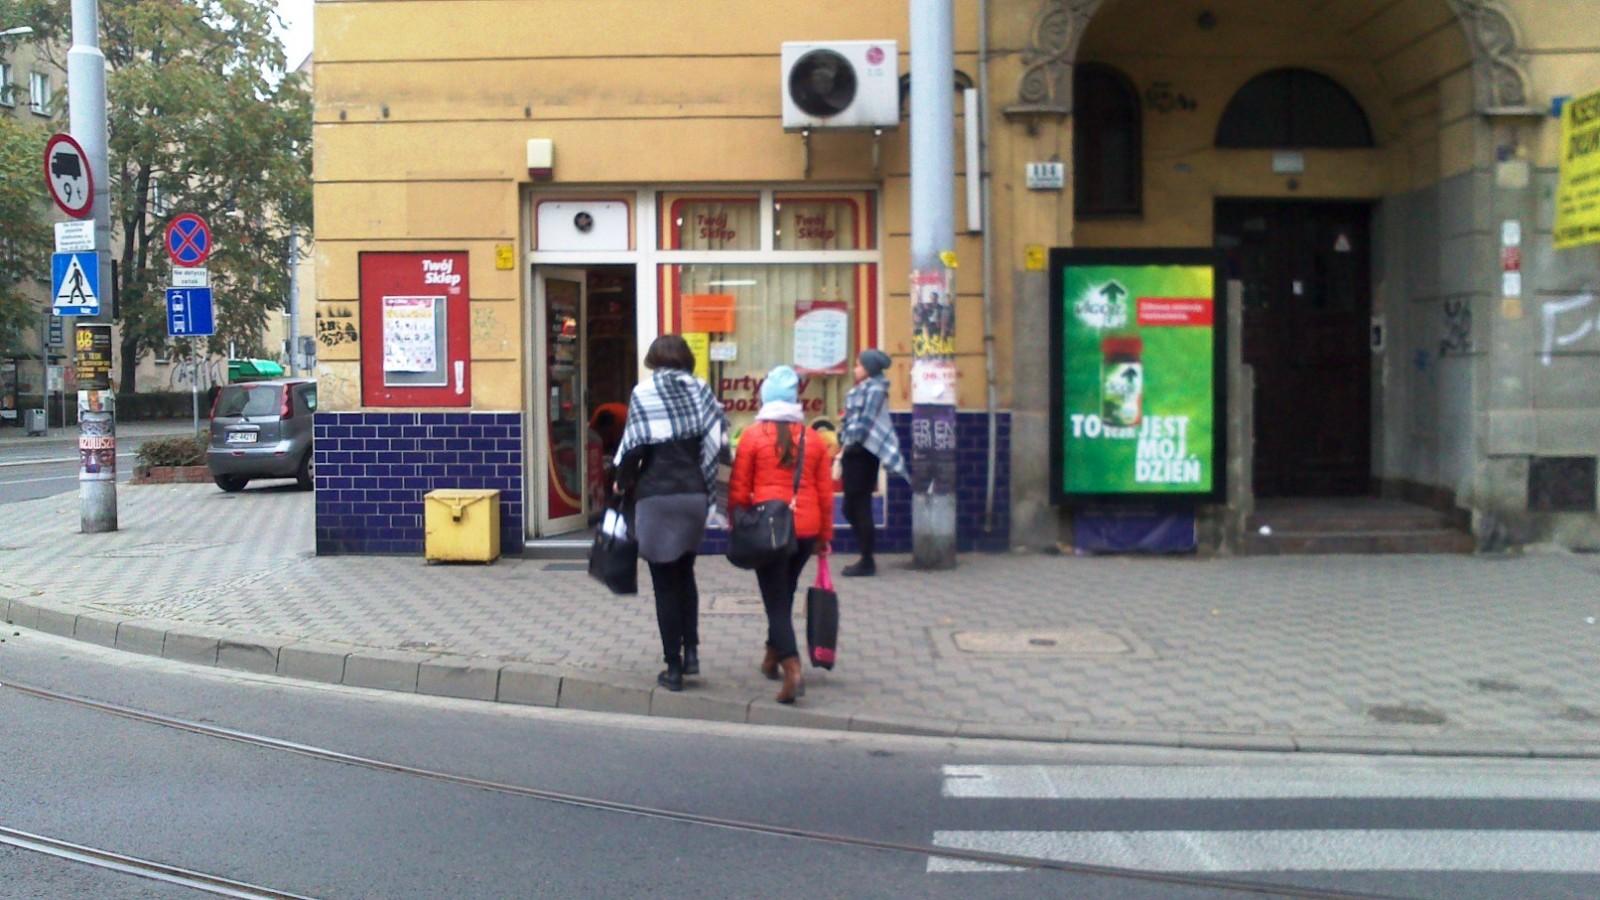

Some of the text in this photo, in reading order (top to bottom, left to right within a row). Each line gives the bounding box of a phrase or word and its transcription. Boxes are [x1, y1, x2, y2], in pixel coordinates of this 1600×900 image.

[63, 182, 72, 203] 9
[697, 213, 728, 228] Twój
[699, 227, 736, 241] Sklep
[797, 227, 835, 241] Sklep
[421, 258, 453, 274] Twój
[424, 272, 461, 287] Sklep
[720, 375, 811, 396] artyy
[1070, 414, 1102, 438] TO
[1139, 415, 1189, 439] JEST
